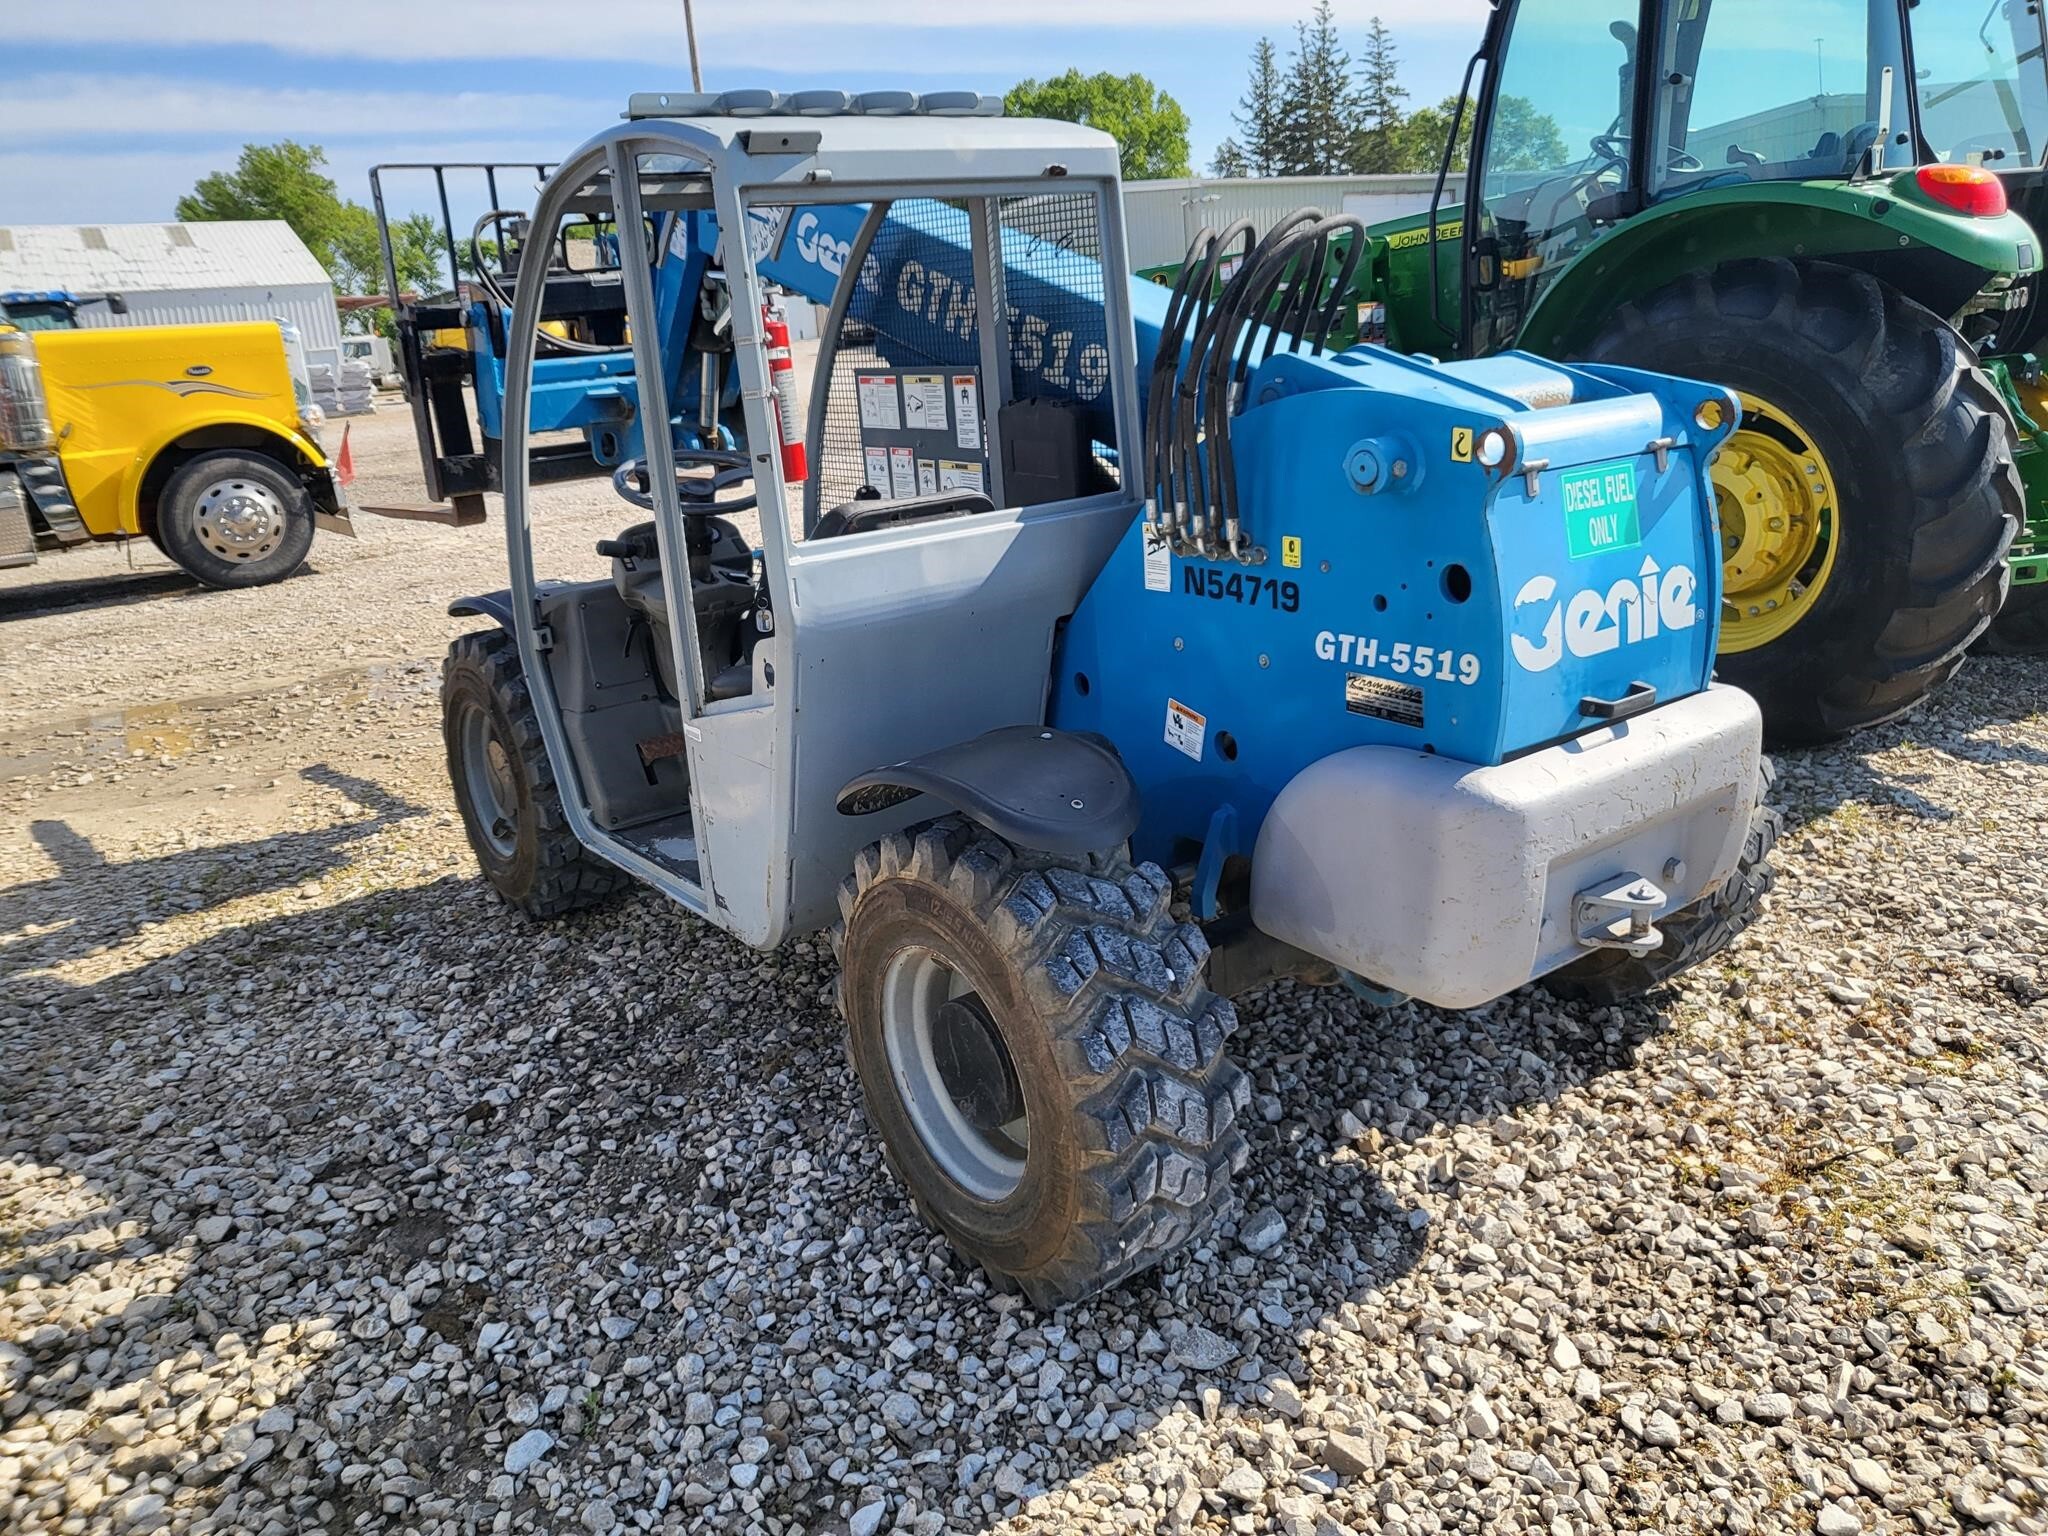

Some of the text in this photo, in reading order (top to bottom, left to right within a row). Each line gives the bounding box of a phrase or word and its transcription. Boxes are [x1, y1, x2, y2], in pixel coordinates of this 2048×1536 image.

[1394, 232, 1428, 249] JOHN
[1564, 472, 1635, 513] DIESEL FUEL
[1588, 514, 1618, 547] ONLY
[1184, 566, 1300, 613] N54719
[1510, 554, 1697, 673] Genie
[1315, 631, 1481, 686] GTH-5519
